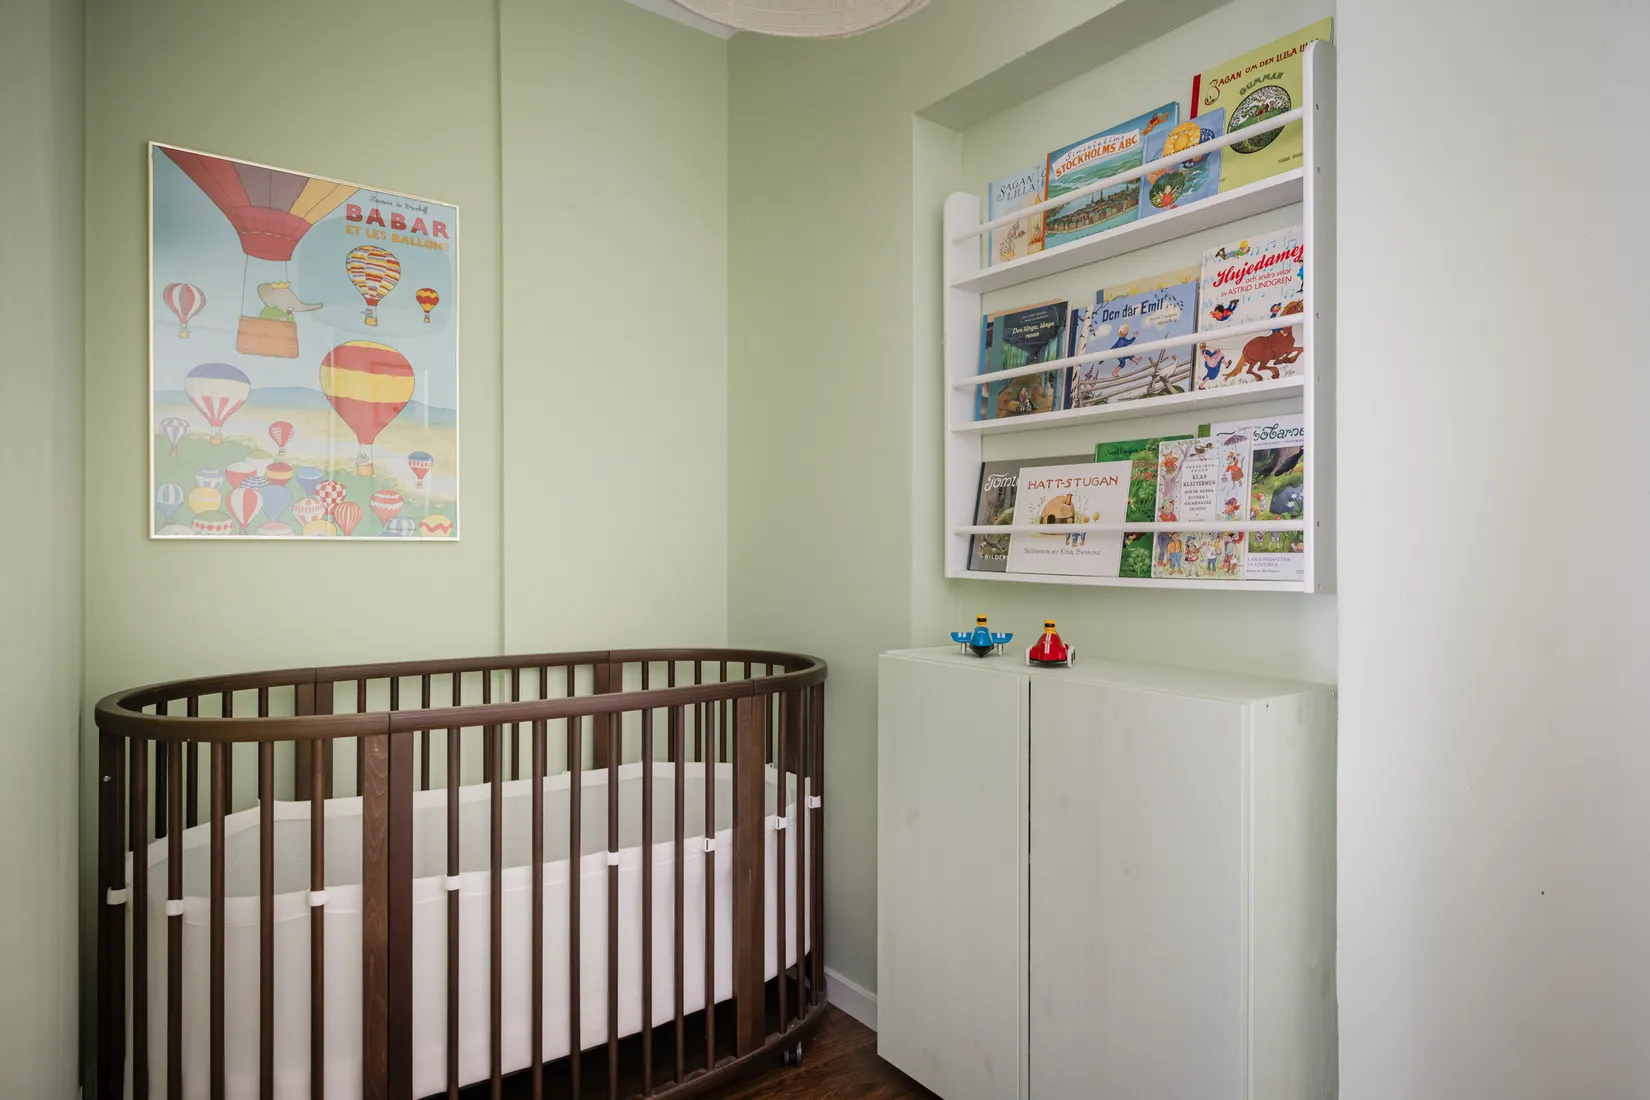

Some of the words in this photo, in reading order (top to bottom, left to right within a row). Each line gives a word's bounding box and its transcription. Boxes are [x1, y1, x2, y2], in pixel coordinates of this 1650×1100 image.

[1204, 71, 1242, 106] SAGAN
[1245, 64, 1258, 74] OM
[1260, 56, 1275, 68] DEN
[1276, 47, 1298, 62] LILLA
[1055, 142, 1116, 178] STOCKHOLMS
[1118, 133, 1139, 150] ABC
[997, 173, 1034, 202] SAGAN
[1007, 183, 1036, 201] LILLA
[345, 203, 450, 240] BABAR
[345, 224, 361, 236] ET
[365, 227, 388, 241] LES
[391, 232, 451, 252] BALLONS
[1228, 284, 1253, 296] ASTRID
[1254, 275, 1293, 290] LINDGREN
[1245, 276, 1257, 284] och
[1258, 271, 1276, 281] andra
[1277, 268, 1293, 276] visor
[1102, 309, 1120, 323] Den
[1122, 304, 1139, 318] där
[1140, 298, 1165, 315] Emil
[1028, 476, 1119, 490] HATT-STUGAN
